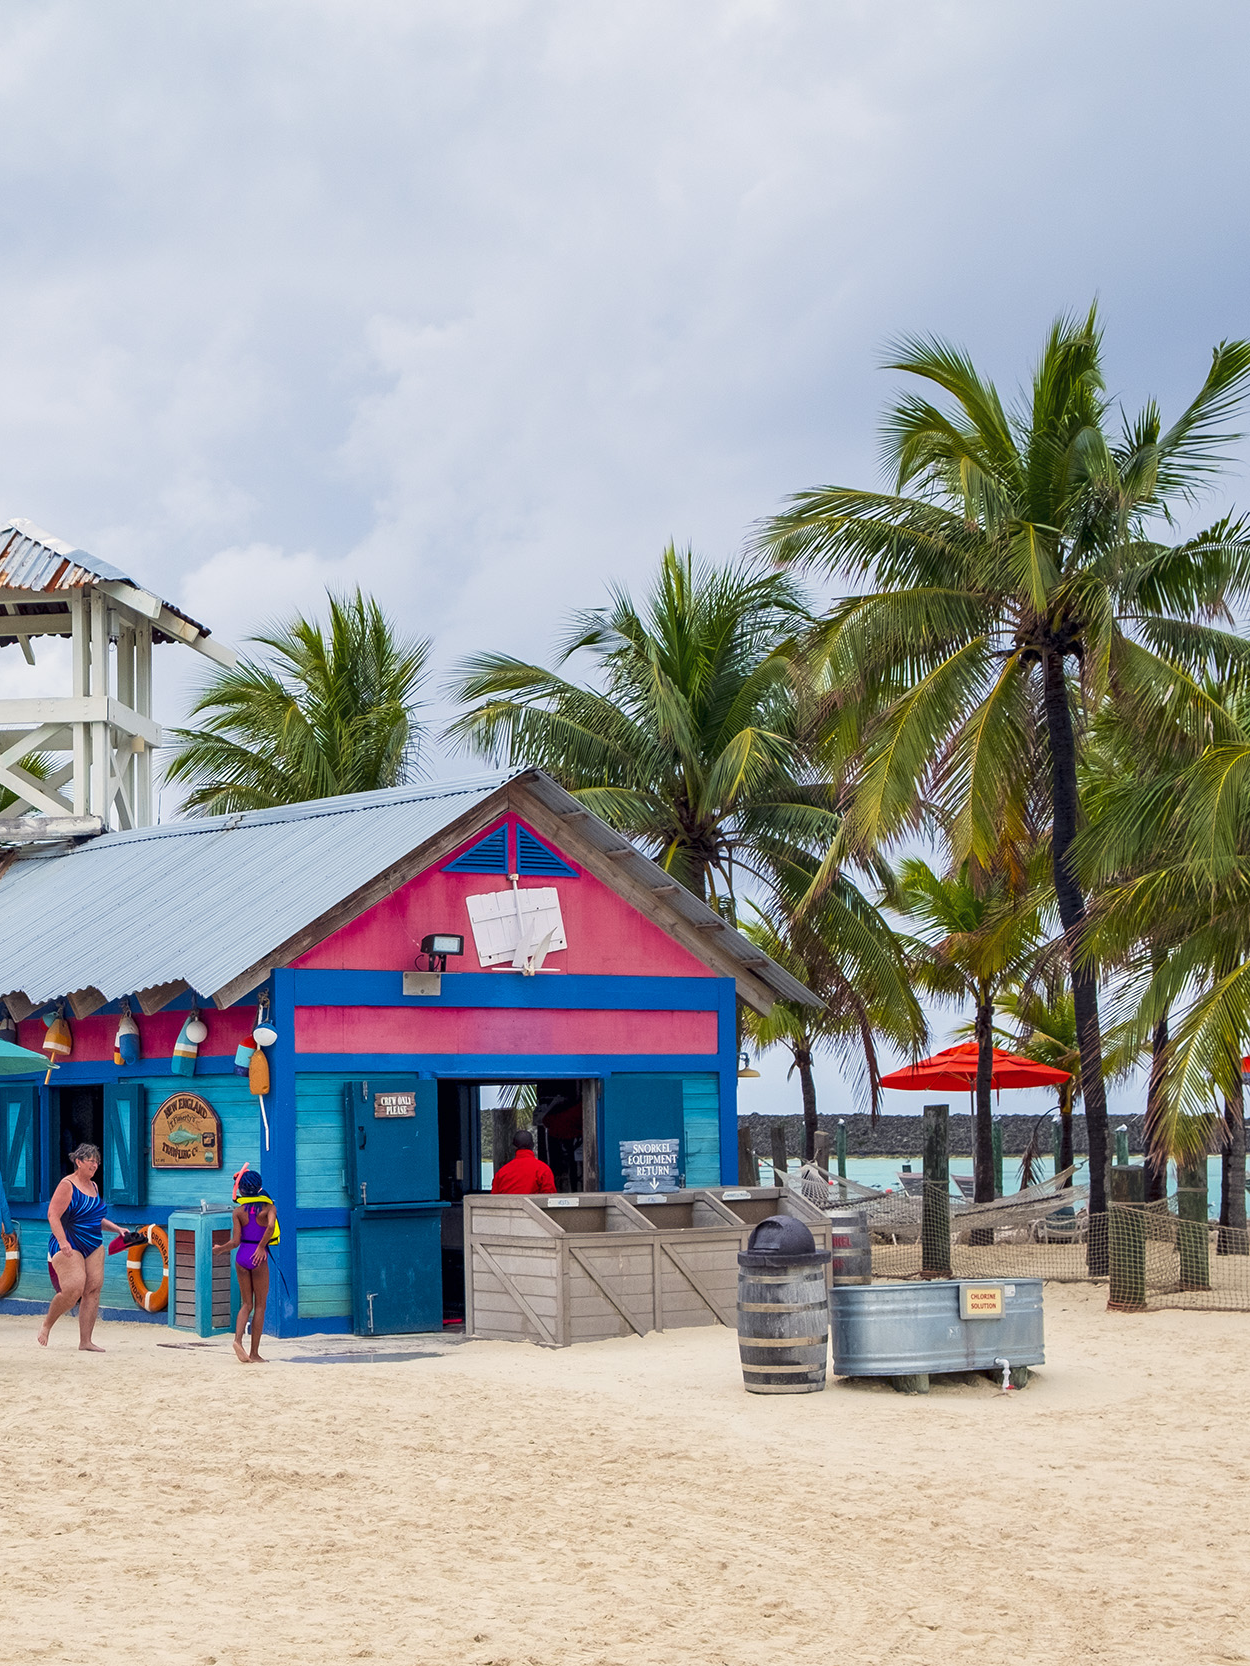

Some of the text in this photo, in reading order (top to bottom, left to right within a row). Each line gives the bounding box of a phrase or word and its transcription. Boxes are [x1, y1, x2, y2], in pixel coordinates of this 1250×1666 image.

[381, 1096, 397, 1106] CREW
[163, 1098, 208, 1119] NEW ENGLAND
[386, 1105, 408, 1115] PLEASE
[633, 1143, 672, 1154] SNORKEL
[628, 1154, 678, 1165] EQUIPMENT
[636, 1166, 669, 1176] RETURN
[128, 1270, 143, 1303] LONDON
